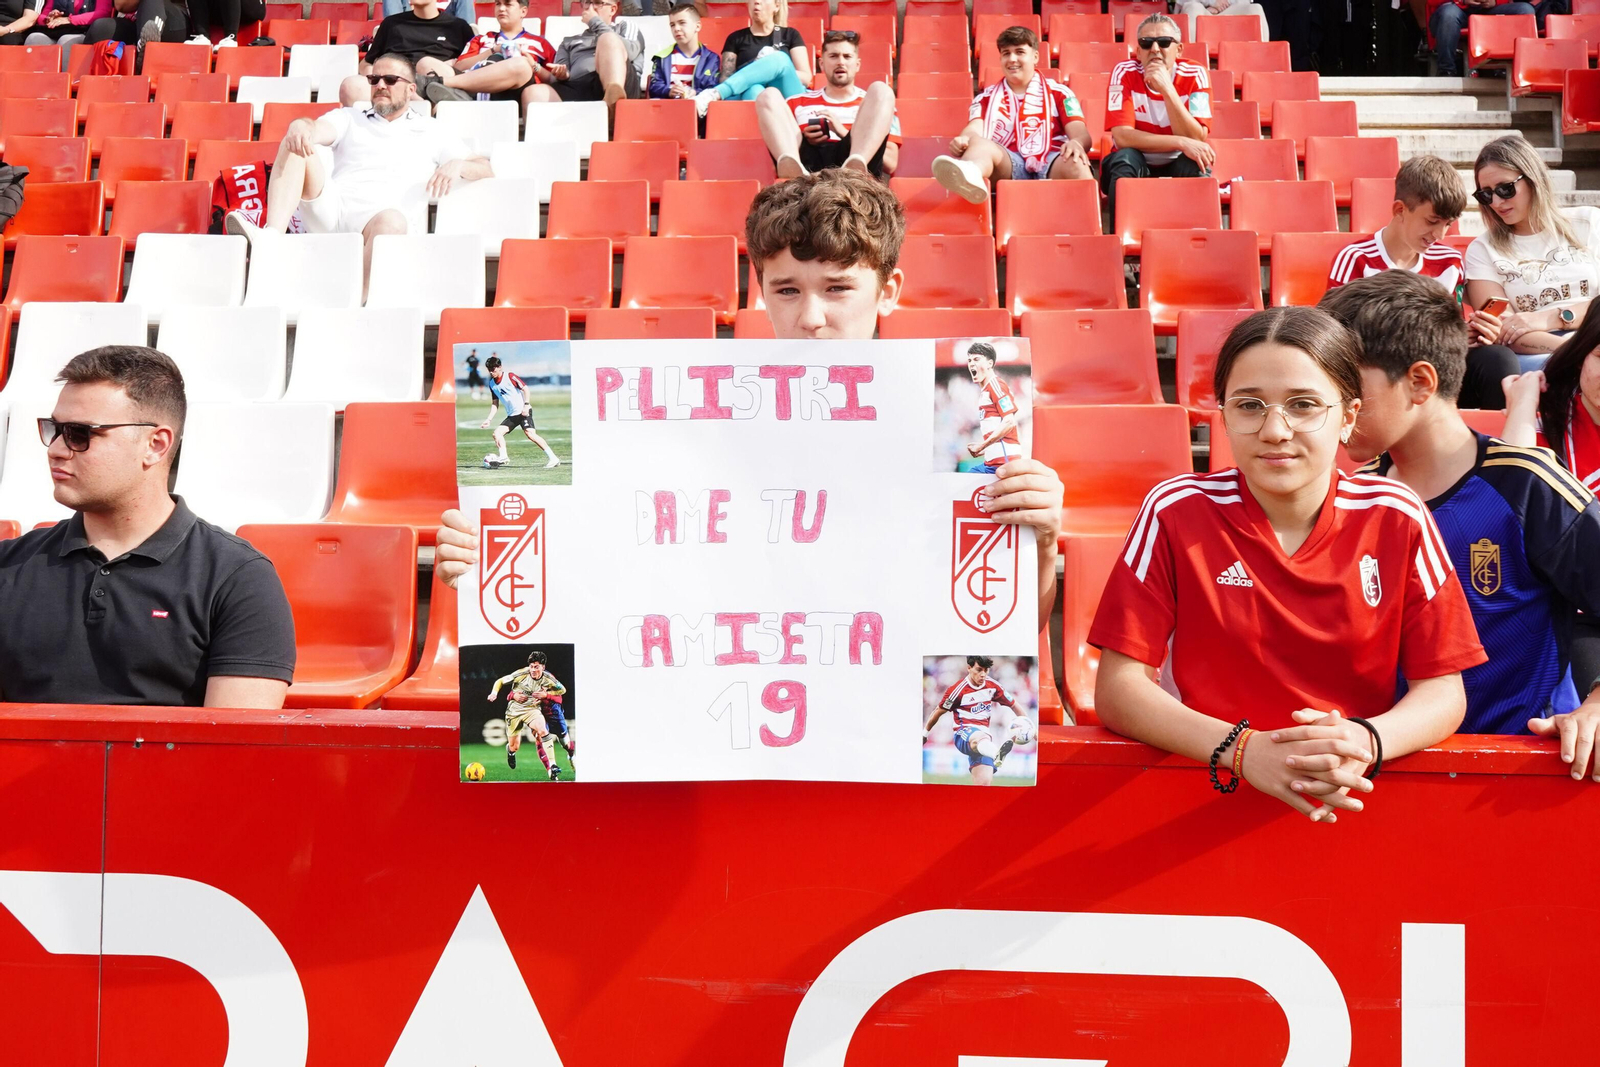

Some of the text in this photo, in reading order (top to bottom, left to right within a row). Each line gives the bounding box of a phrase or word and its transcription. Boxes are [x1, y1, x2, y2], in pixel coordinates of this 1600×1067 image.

[596, 365, 877, 422] PELLISTRI
[635, 489, 827, 545] DAME TU
[1216, 576, 1254, 587] adidas
[617, 612, 884, 668] CAMISETA
[707, 680, 806, 749] 19
